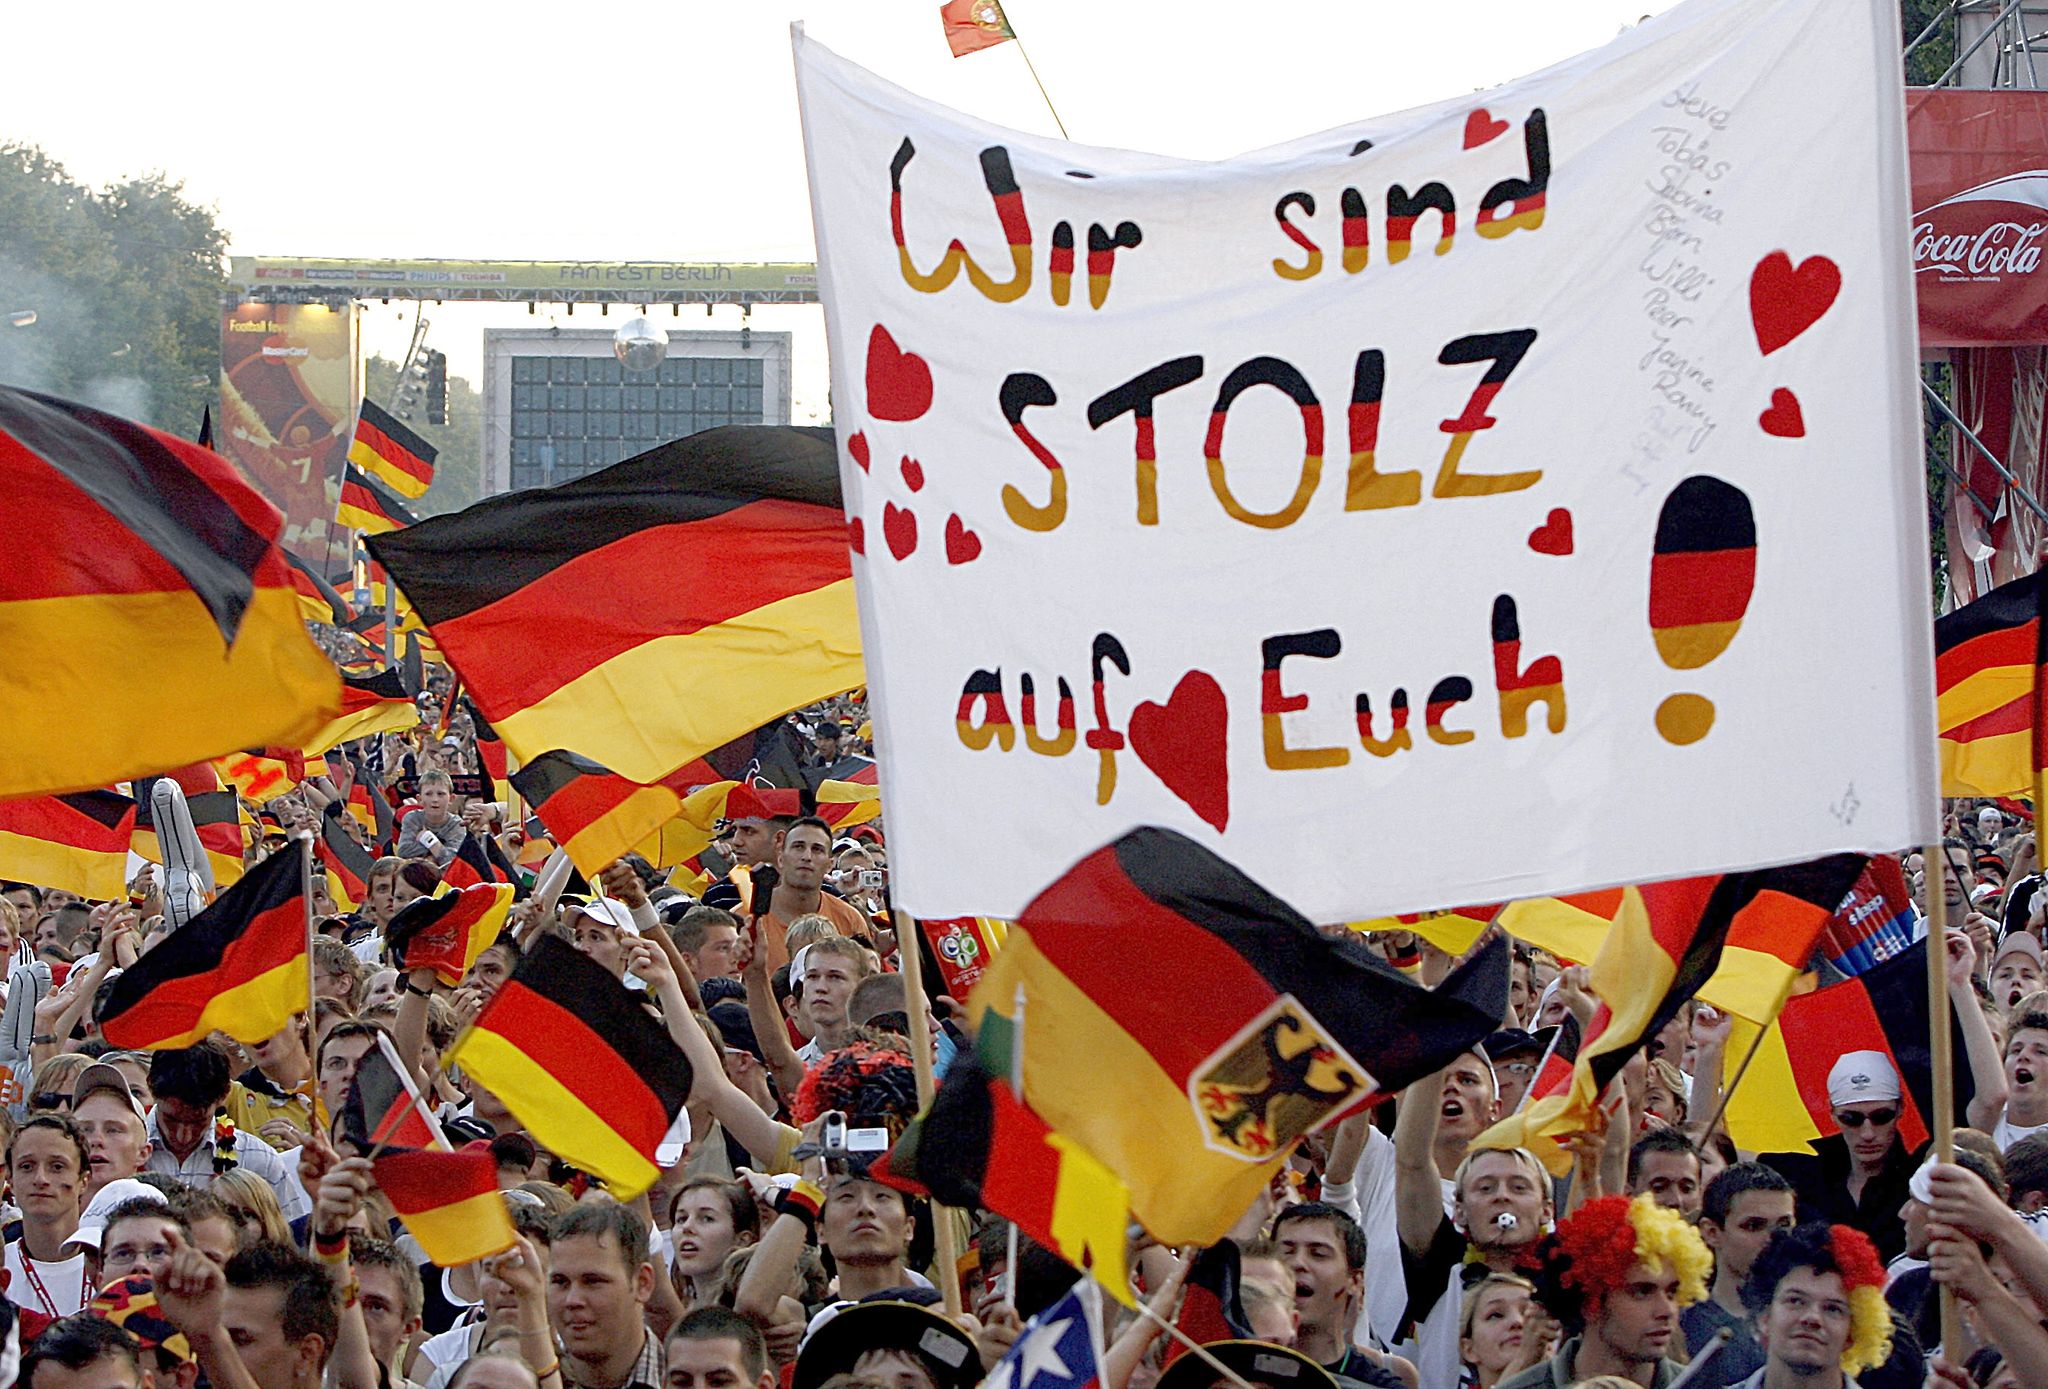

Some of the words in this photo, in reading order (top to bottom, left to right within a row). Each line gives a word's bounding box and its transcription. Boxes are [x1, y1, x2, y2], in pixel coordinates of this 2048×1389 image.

[1651, 126, 1731, 181] Tobias
[889, 136, 1143, 310] Wir
[1272, 107, 1551, 281] sind
[410, 271, 450, 281] PHILIPS
[461, 273, 502, 282] TOSHIBA
[560, 266, 600, 280] FAN
[606, 266, 653, 281] FEST
[660, 266, 732, 281] BERLIN
[1639, 244, 1715, 301] Willi
[1638, 330, 1715, 393] Janine
[998, 328, 1543, 532] STOLZ
[292, 456, 312, 484] 7
[956, 632, 1131, 806] auf
[1261, 594, 1567, 771] Euch
